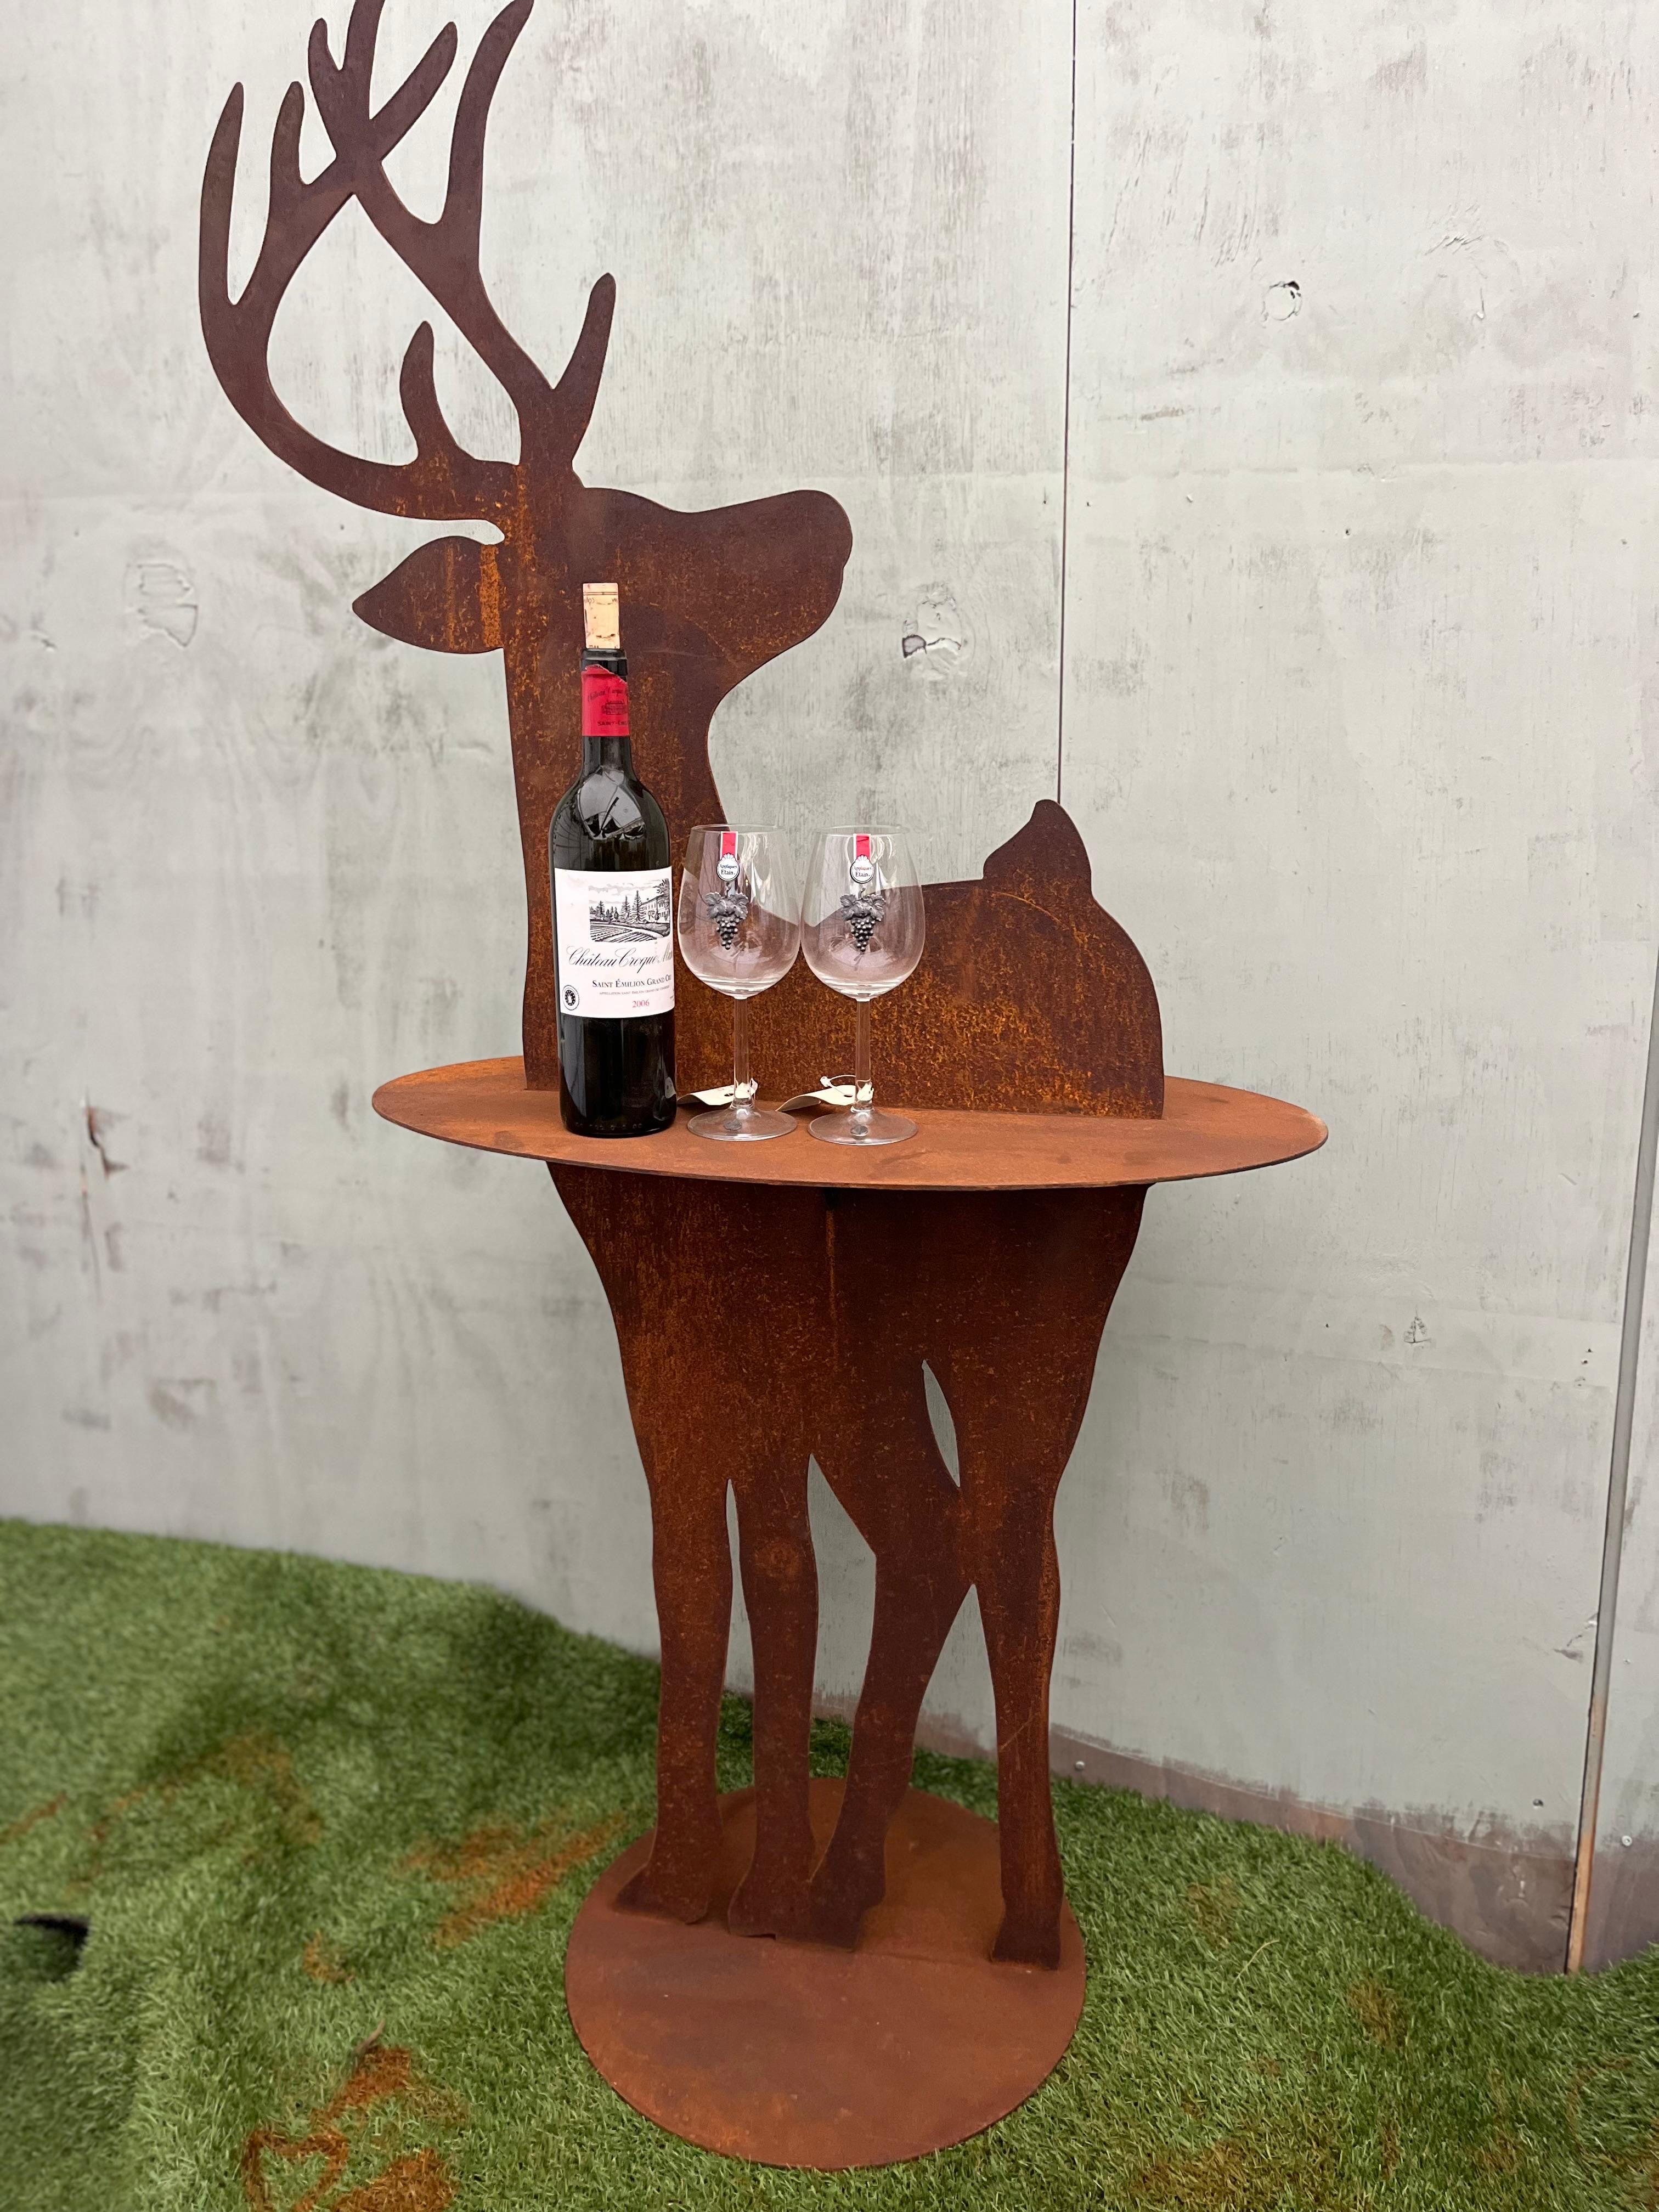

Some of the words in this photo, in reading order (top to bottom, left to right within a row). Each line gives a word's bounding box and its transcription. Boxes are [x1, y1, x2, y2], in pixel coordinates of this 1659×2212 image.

[566, 945, 617, 967] Château
[614, 947, 659, 974] Croque
[592, 980, 613, 988] SAINT
[615, 978, 645, 988] ÉMILION
[646, 977, 665, 986] GRAND
[632, 998, 650, 1008] 2006
